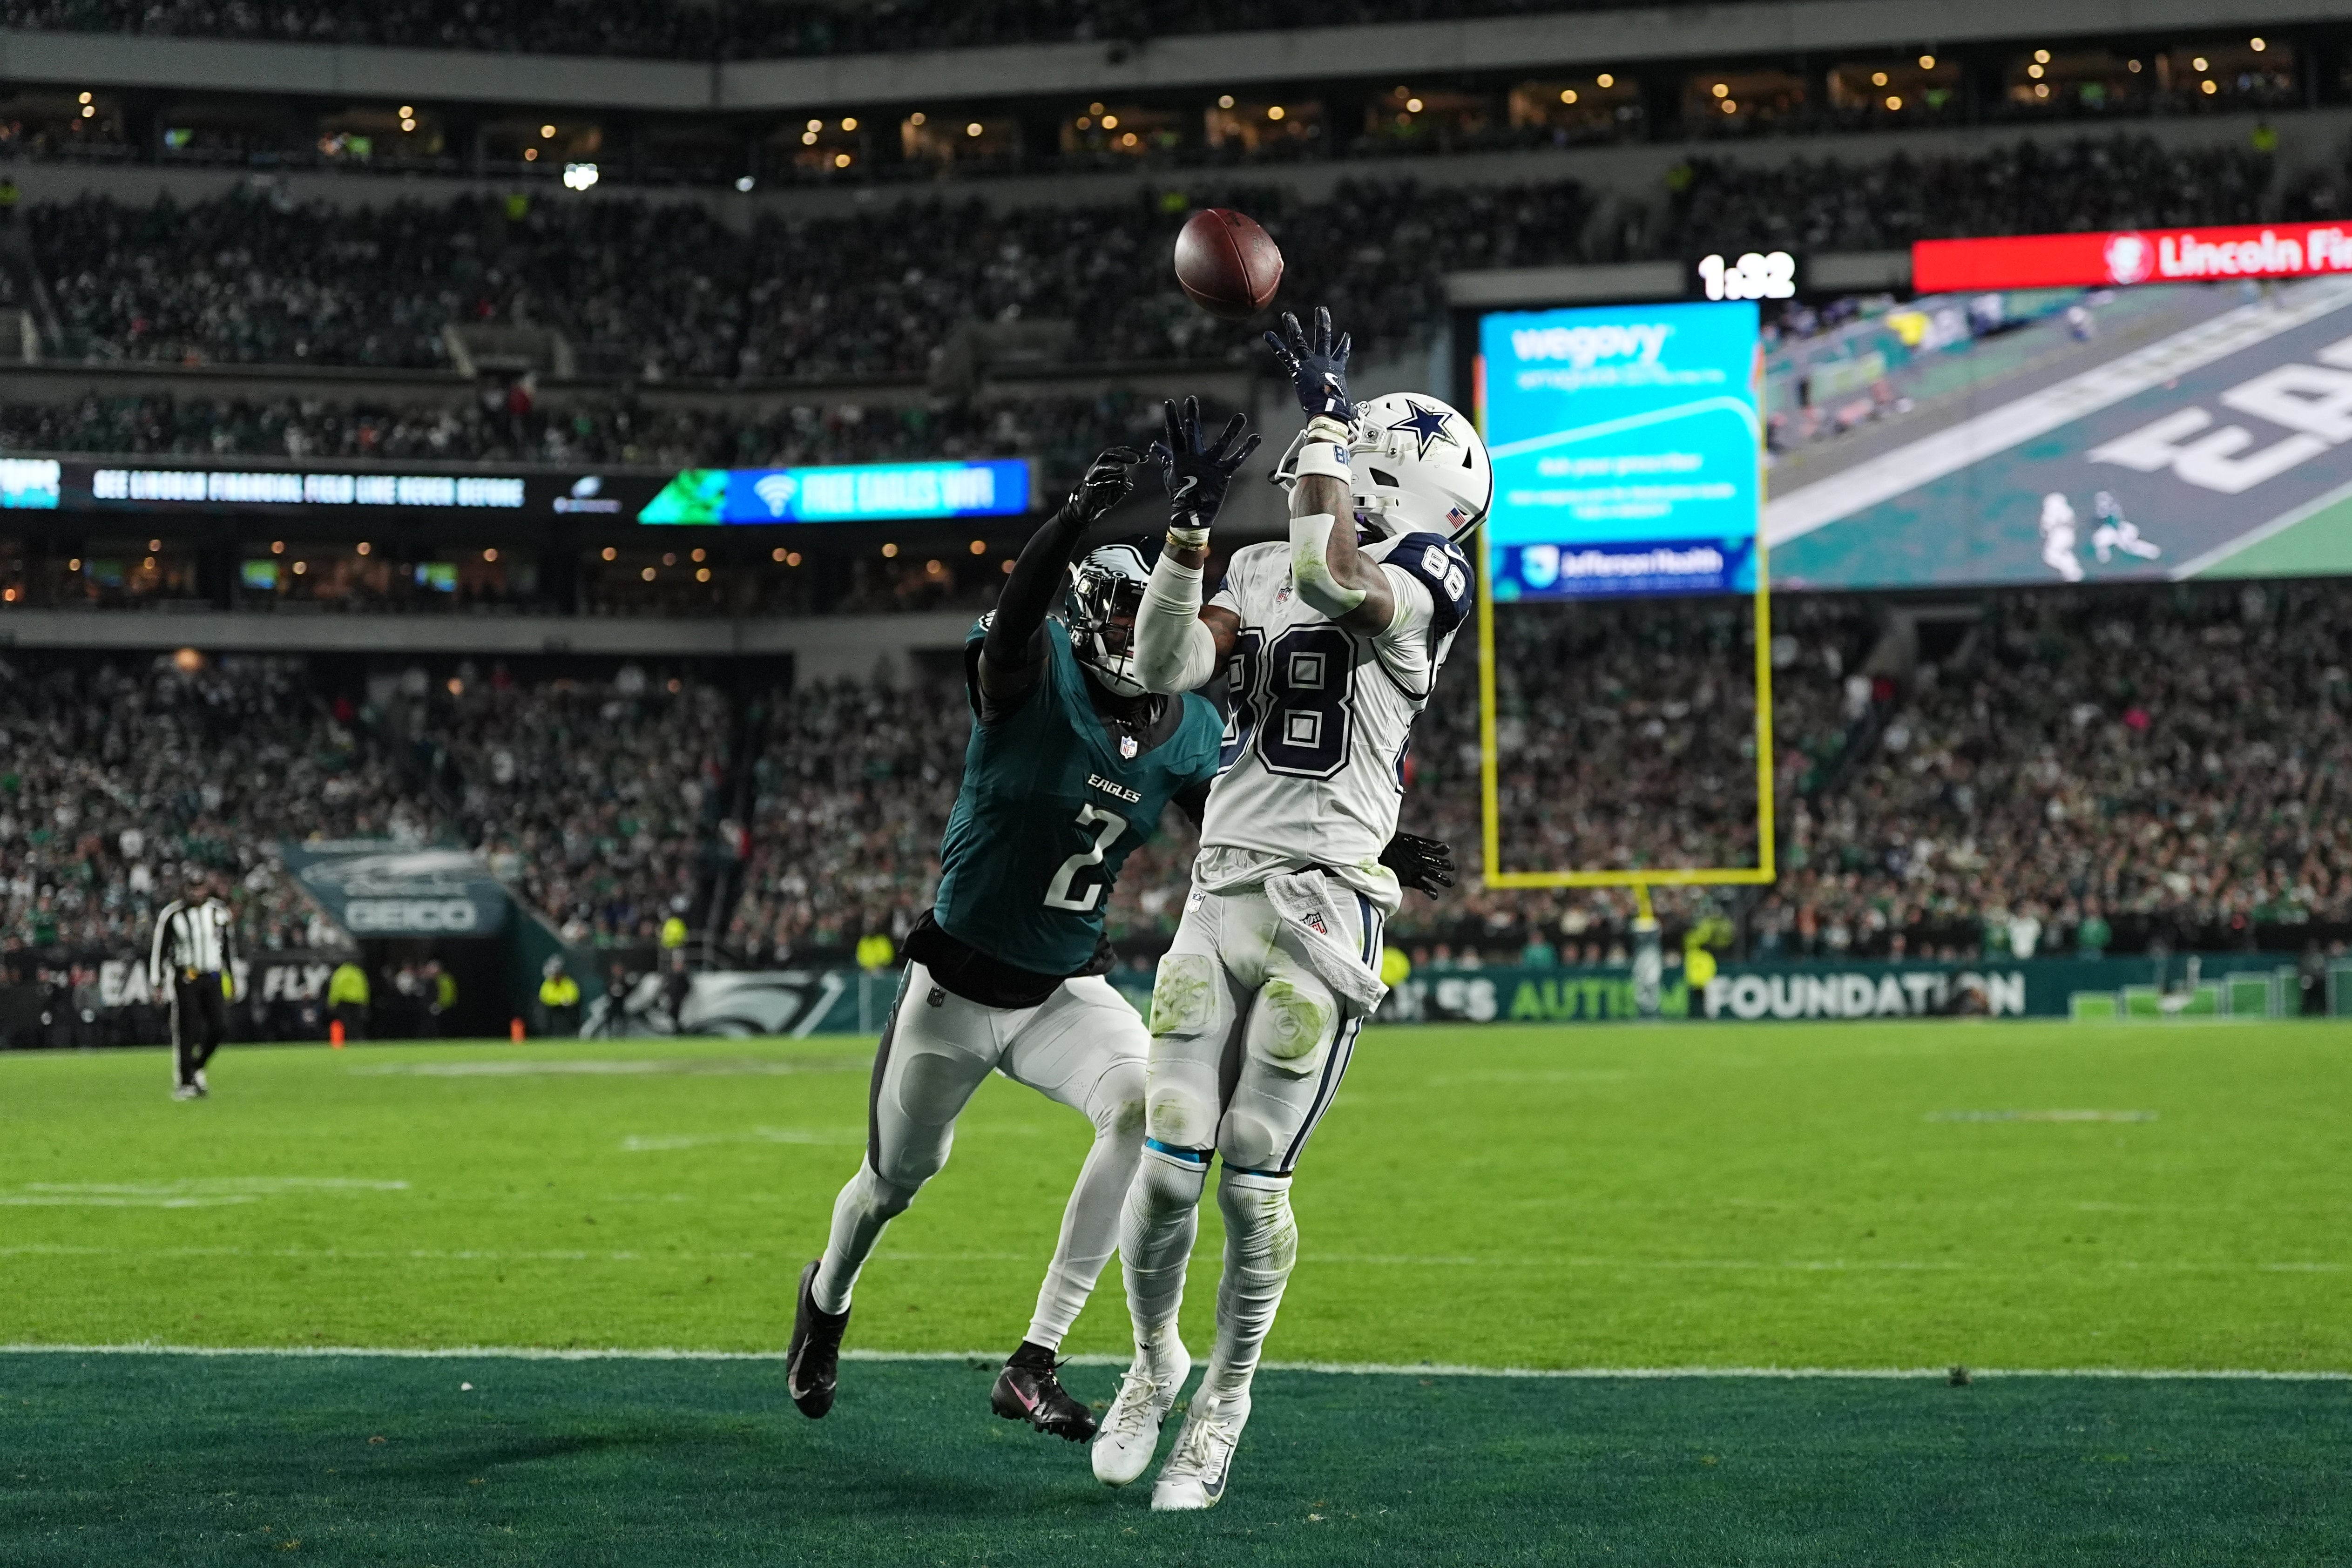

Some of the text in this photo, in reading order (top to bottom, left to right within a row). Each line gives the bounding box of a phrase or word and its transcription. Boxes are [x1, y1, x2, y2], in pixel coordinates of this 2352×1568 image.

[2159, 230, 2303, 277] Lincoln
[1512, 324, 1668, 370] wegovy
[1421, 545, 1466, 602] 88
[1277, 593, 1288, 601] NFL
[1217, 622, 1359, 781] 88
[1123, 745, 1133, 755] NFL
[1088, 773, 1142, 804] EAGLES
[1042, 801, 1129, 912] 2
[345, 899, 477, 931] GEICO
[262, 963, 331, 1004] FLY
